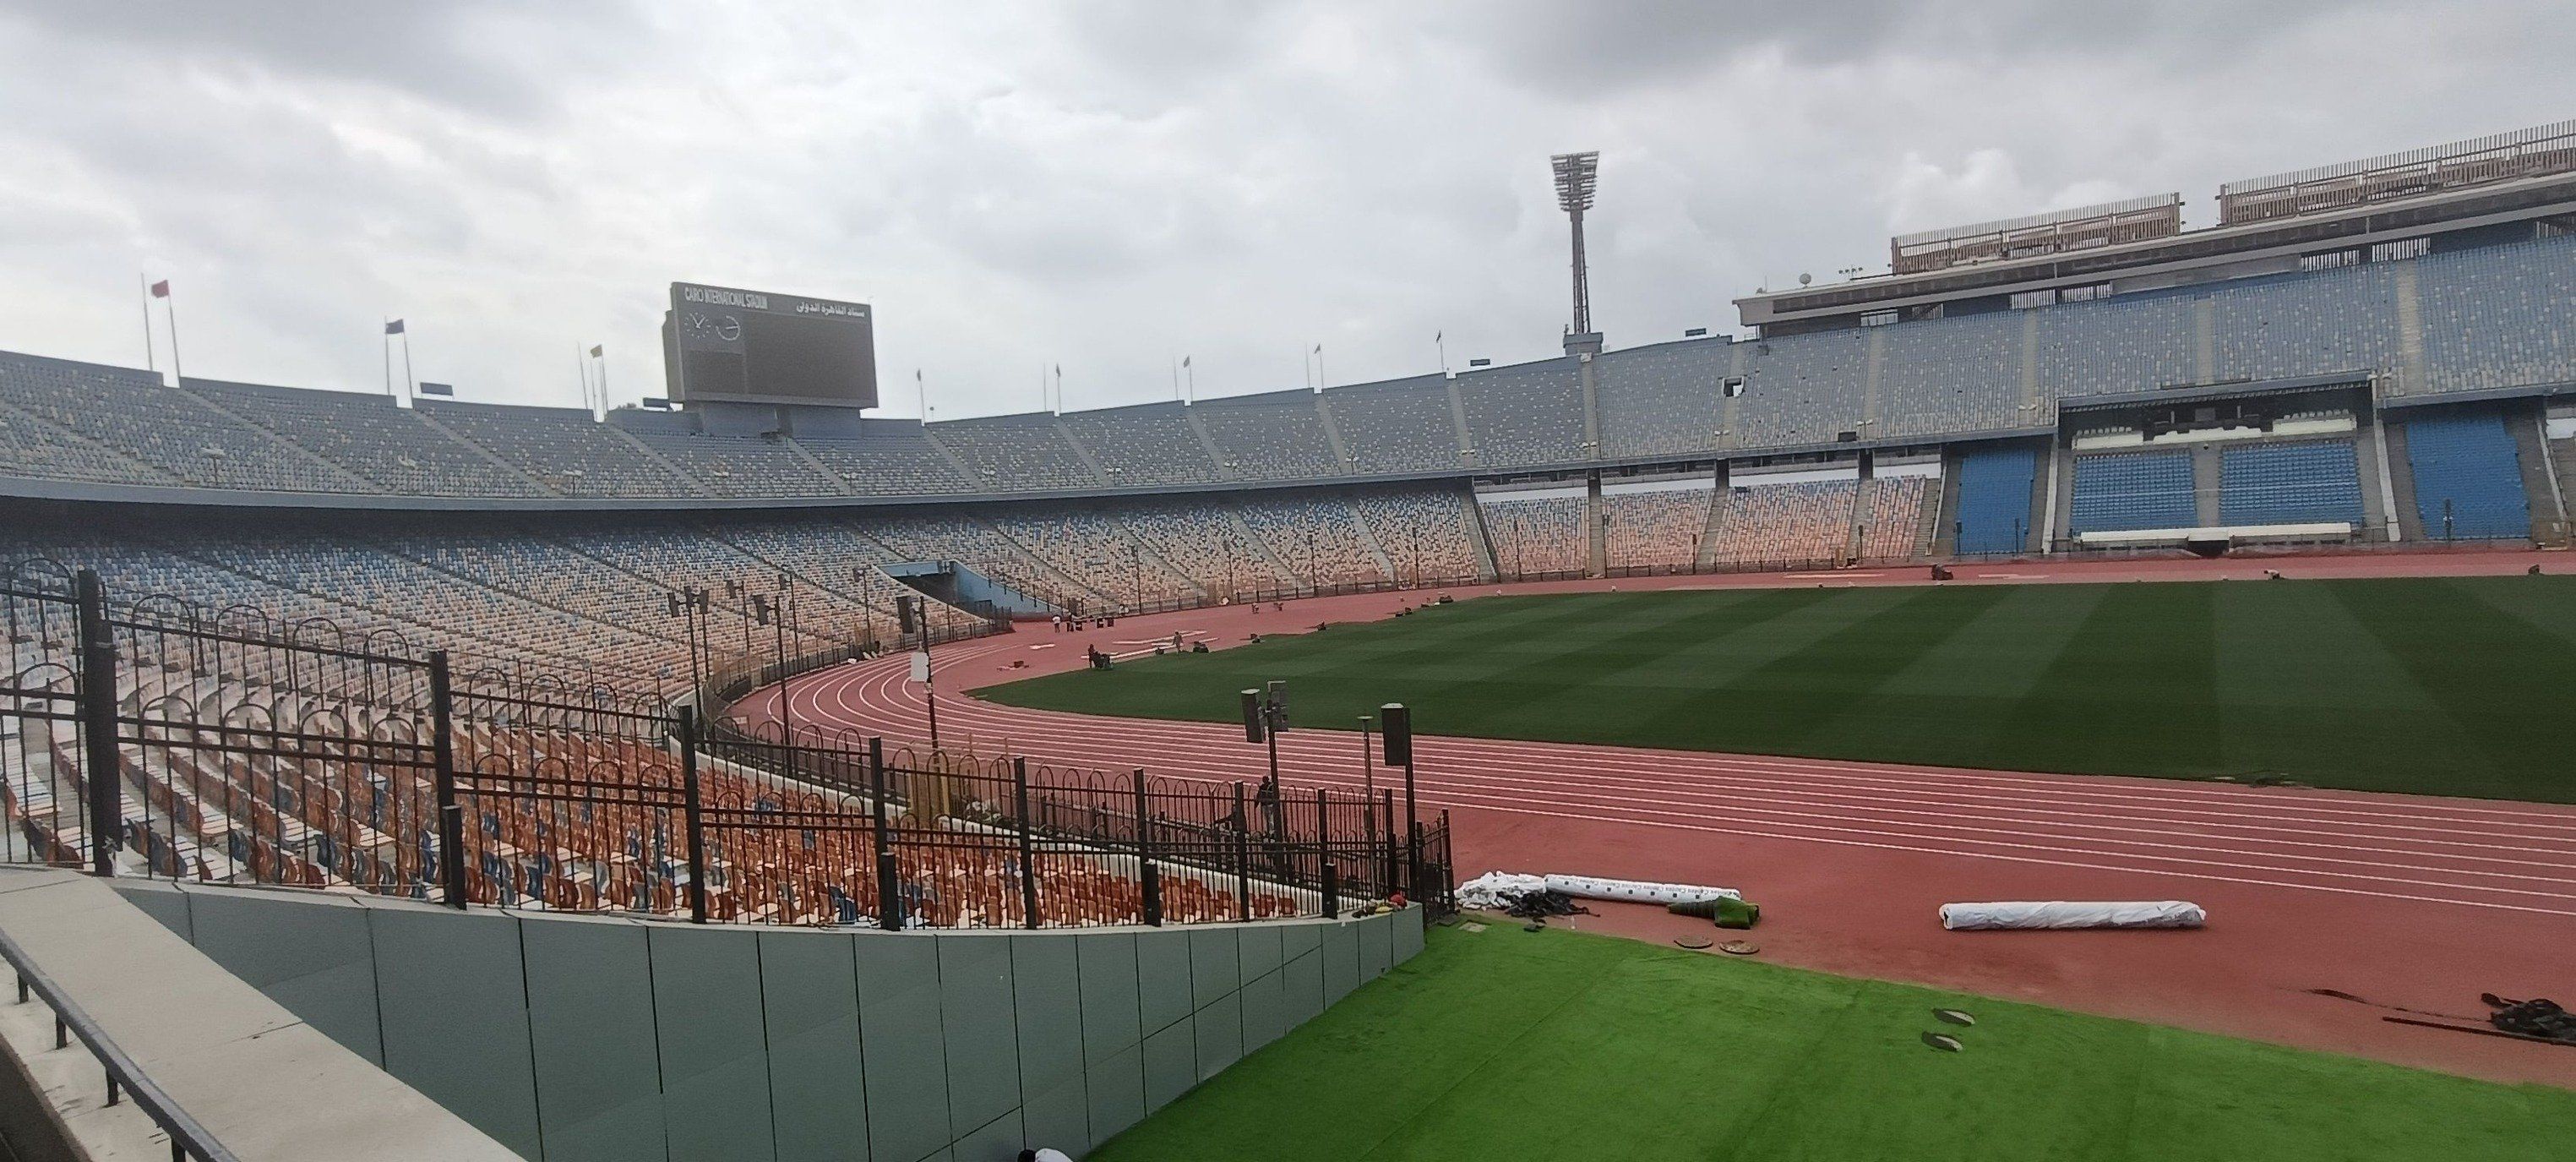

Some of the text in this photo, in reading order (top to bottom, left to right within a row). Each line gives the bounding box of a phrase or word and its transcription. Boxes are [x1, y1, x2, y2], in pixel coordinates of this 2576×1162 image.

[684, 286, 768, 310] CAIRO INTERNATIONAL STADIUM
